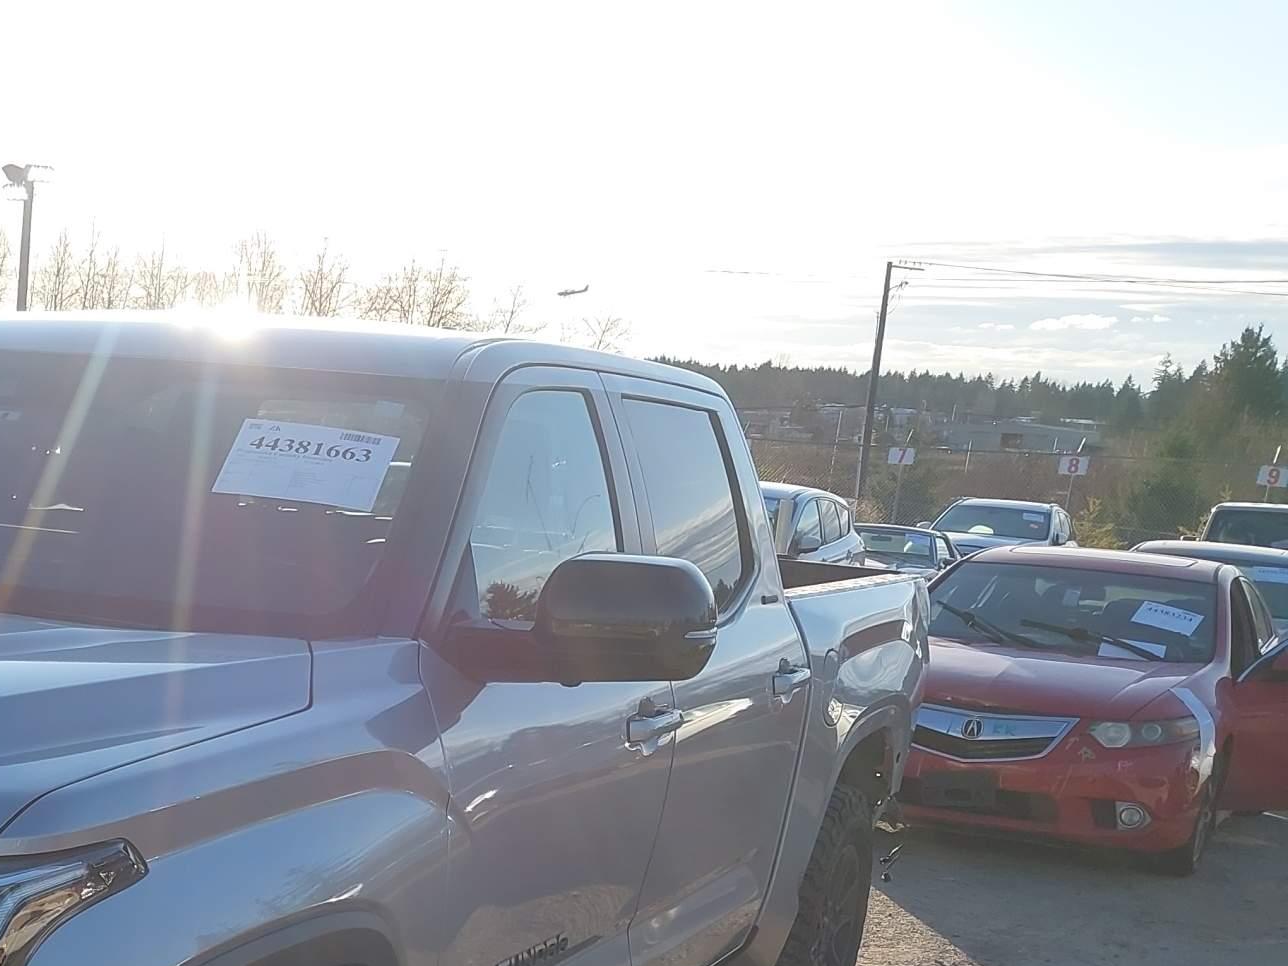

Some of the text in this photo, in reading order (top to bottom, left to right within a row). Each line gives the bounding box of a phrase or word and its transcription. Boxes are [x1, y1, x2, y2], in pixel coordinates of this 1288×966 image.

[248, 435, 373, 463] 44381663
[898, 447, 907, 464] 7
[1067, 457, 1080, 474] 8
[1266, 468, 1281, 486] 9
